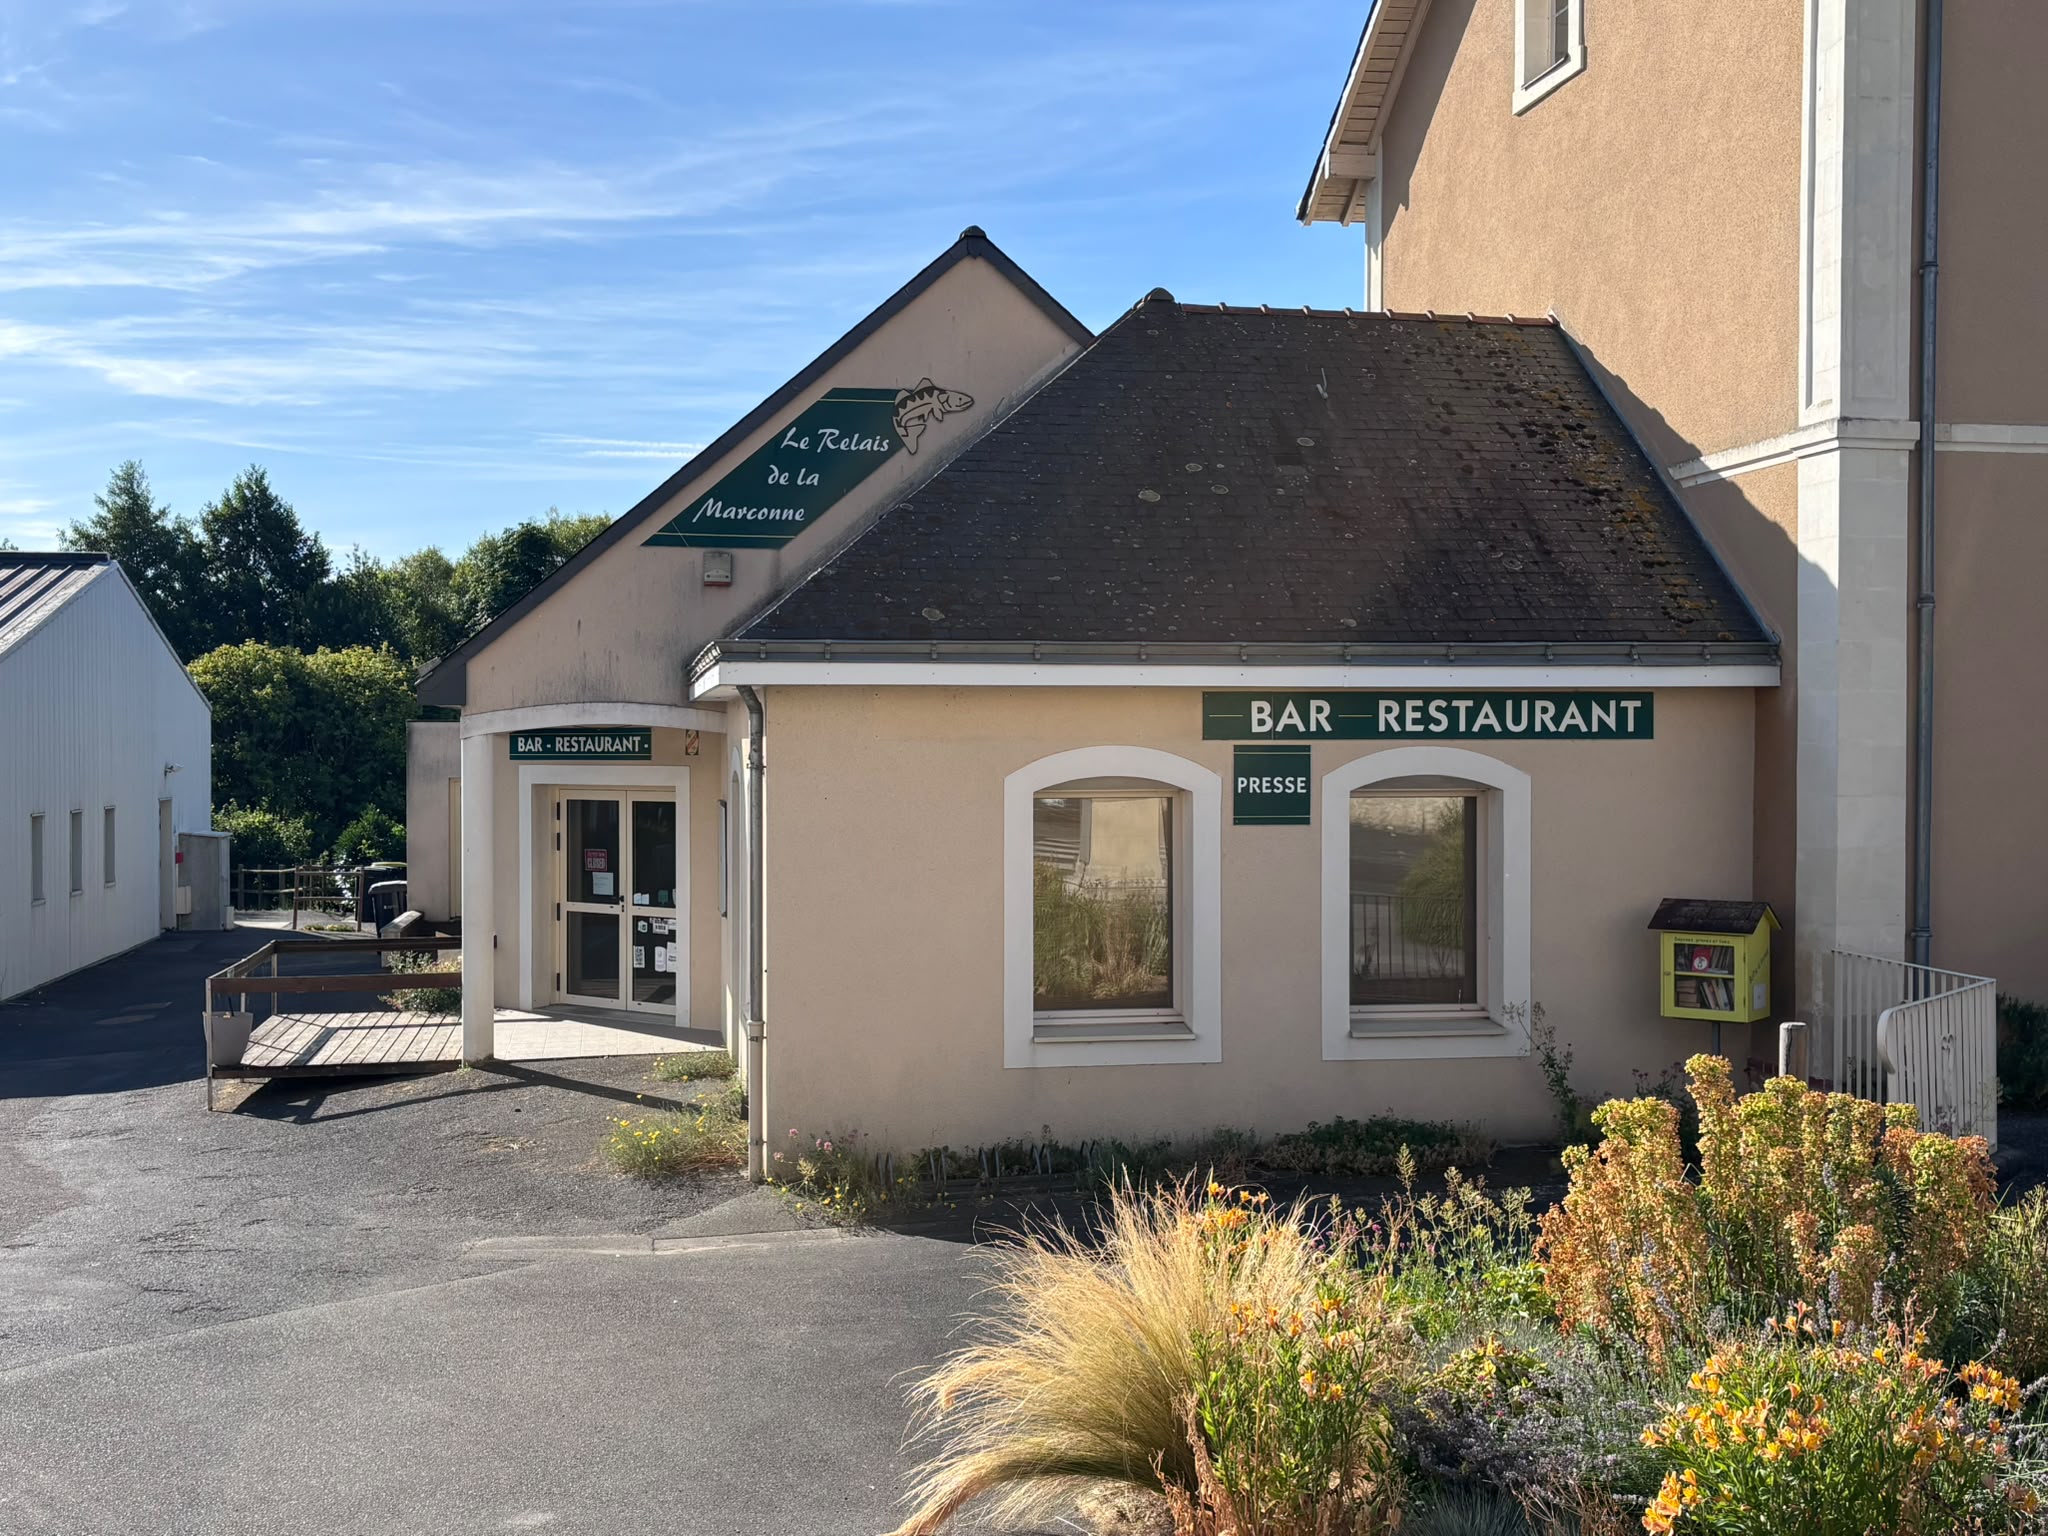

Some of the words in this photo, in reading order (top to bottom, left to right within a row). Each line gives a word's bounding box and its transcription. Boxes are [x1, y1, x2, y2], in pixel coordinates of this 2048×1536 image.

[780, 427, 810, 450] Le
[817, 428, 890, 453] Relais
[767, 464, 790, 486] de
[797, 466, 820, 487] la
[692, 498, 805, 523] Marconne
[1250, 700, 1332, 733] BAR
[1378, 700, 1642, 733] RESTAURANT
[517, 737, 543, 752] BAR
[555, 736, 641, 752] RESTAURANT
[1237, 776, 1307, 794] PRESSE
